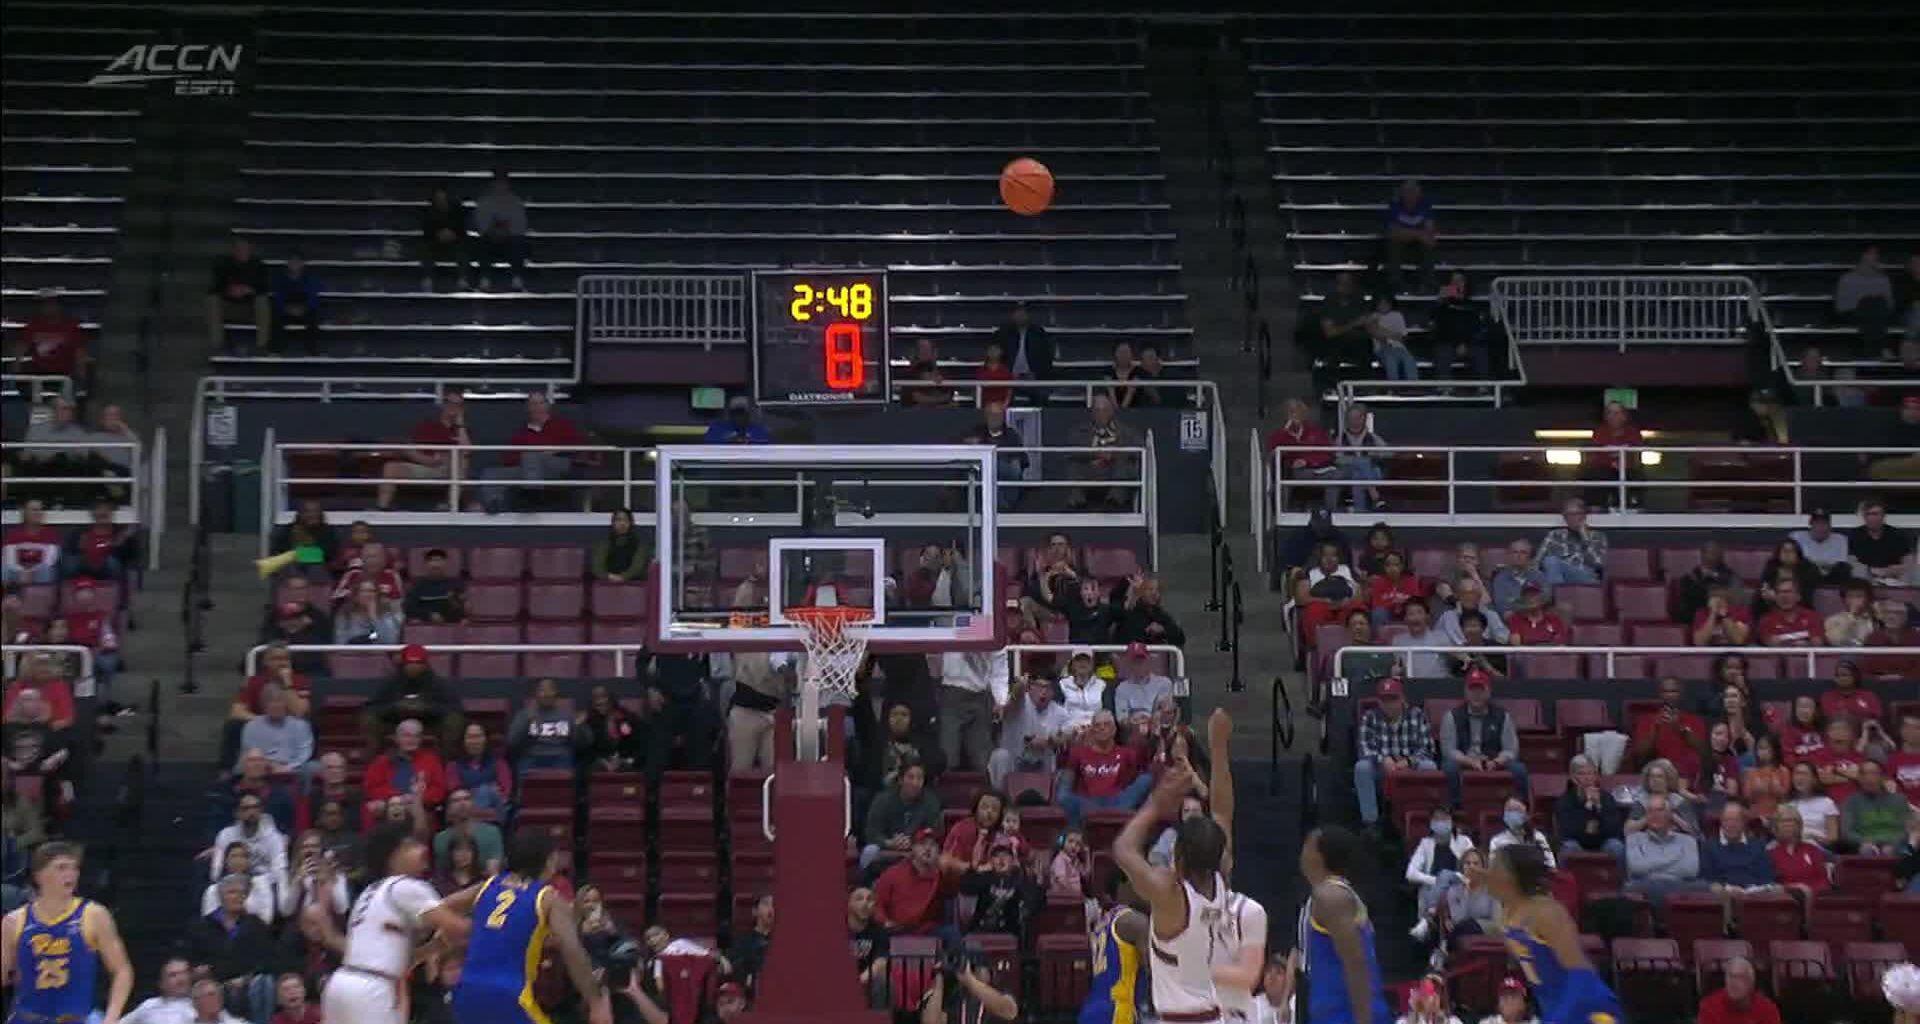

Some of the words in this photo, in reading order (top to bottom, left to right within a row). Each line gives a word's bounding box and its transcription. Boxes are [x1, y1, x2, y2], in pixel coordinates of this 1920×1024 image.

[791, 284, 872, 320] 2:48
[825, 323, 864, 389] 8
[1183, 419, 1203, 438] 15
[486, 889, 516, 928] 2
[36, 958, 70, 989] 25
